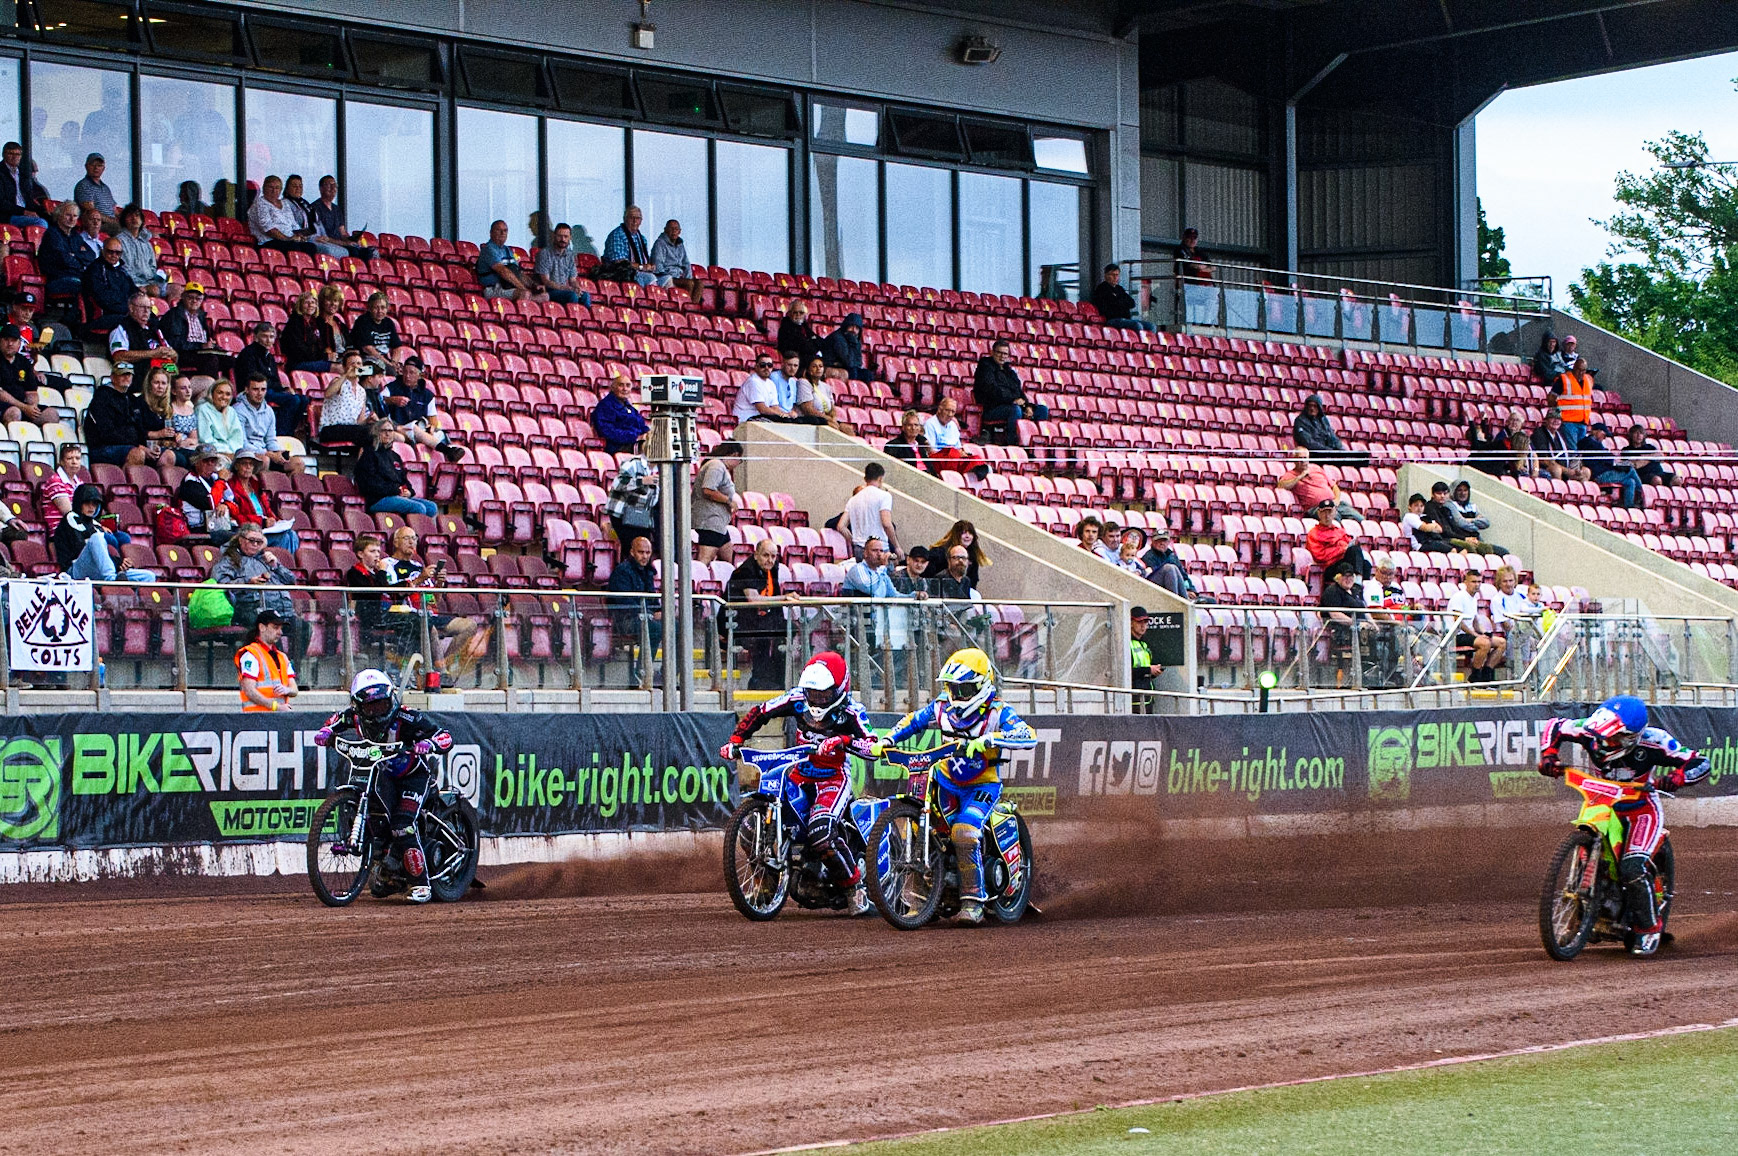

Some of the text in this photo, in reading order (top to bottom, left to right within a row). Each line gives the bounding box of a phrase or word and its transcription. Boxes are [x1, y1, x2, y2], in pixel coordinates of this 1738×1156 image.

[15, 586, 89, 638] BELLE VUE
[1148, 616, 1164, 624] OCK
[30, 648, 80, 666] COLTS
[1416, 720, 1548, 768] BIKERIGH
[494, 752, 729, 818] bike-right.com
[1167, 746, 1344, 801] bike-right.com
[223, 806, 336, 830] MOTORBIE
